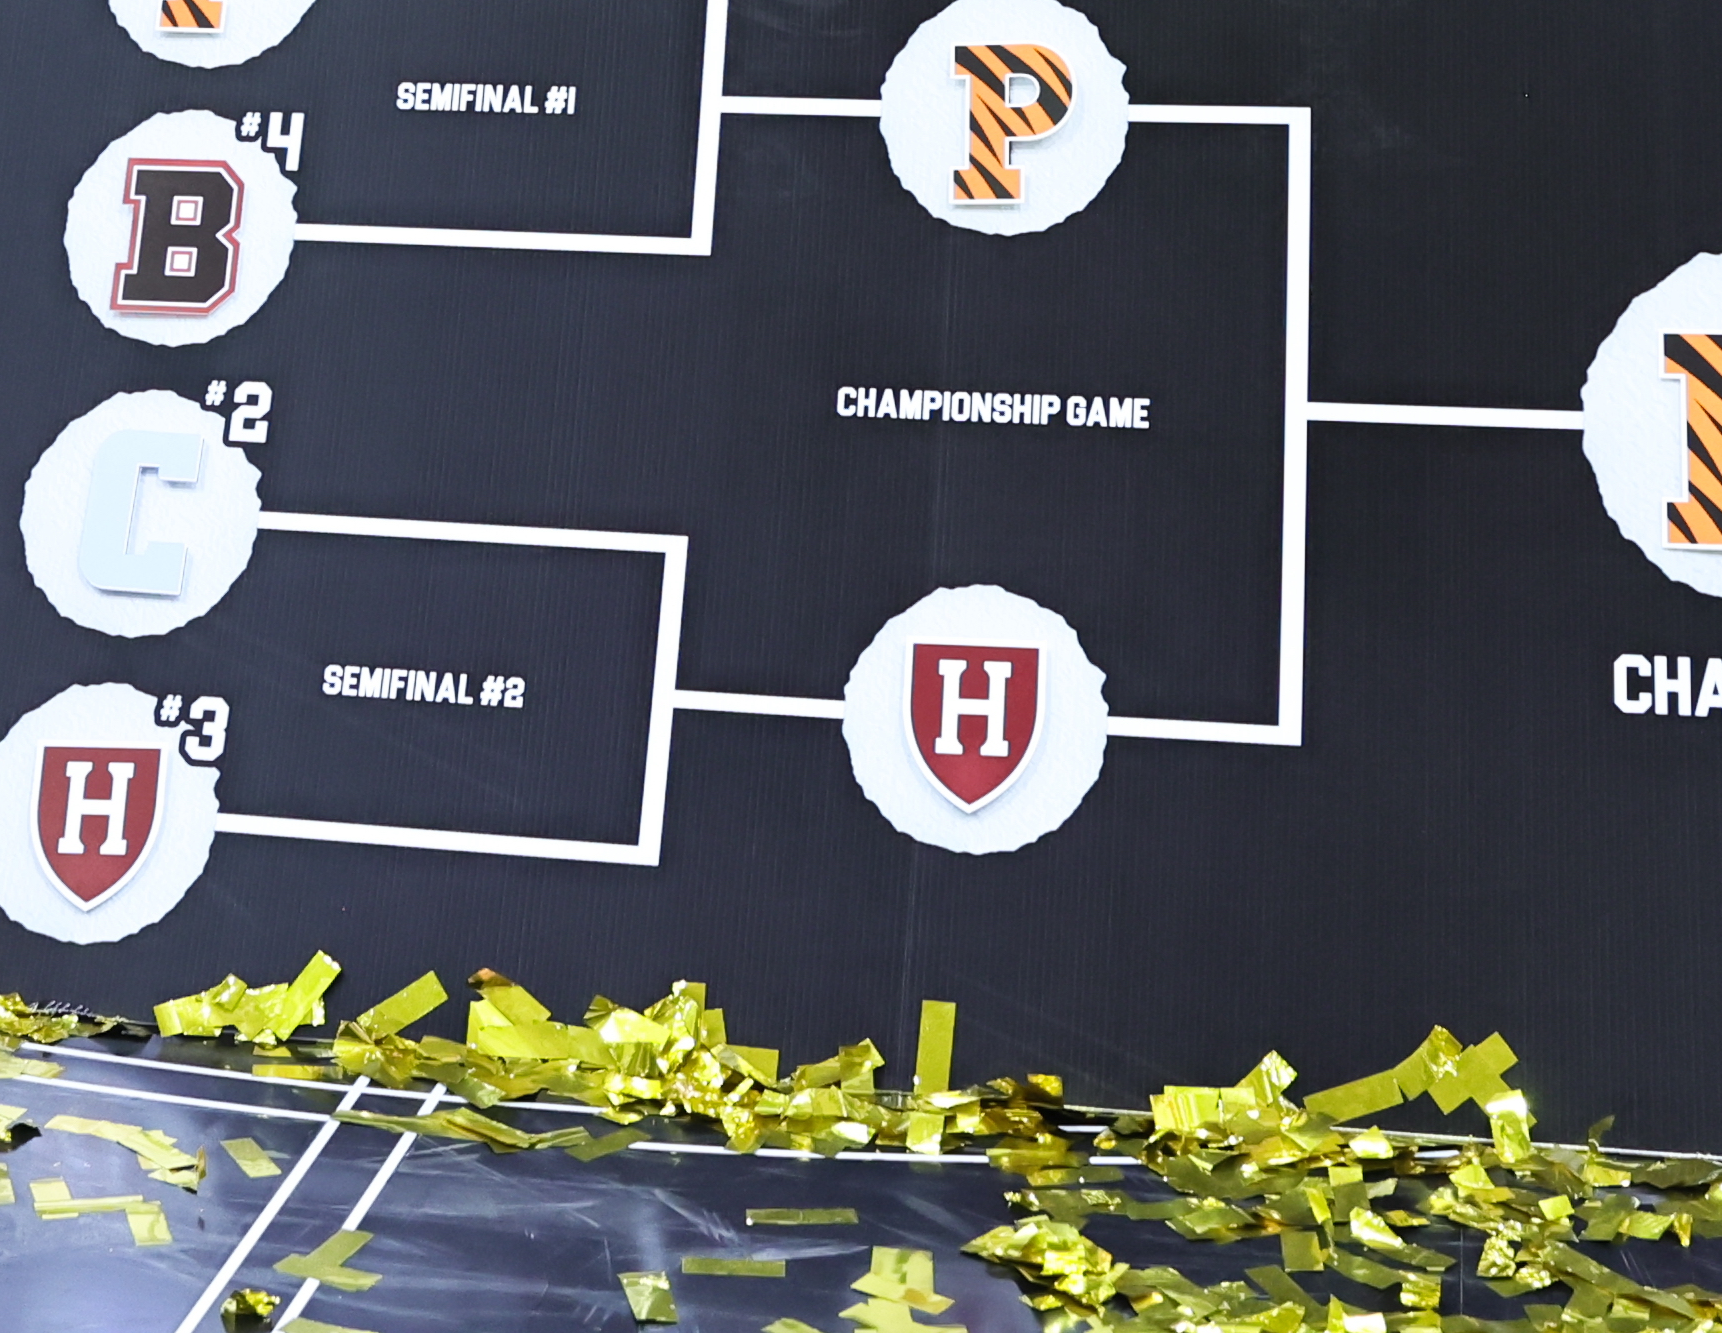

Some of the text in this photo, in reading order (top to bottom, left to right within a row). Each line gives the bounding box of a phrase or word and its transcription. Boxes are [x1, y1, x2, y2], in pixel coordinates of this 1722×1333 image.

[396, 82, 577, 116] SEMIFINAL #1
[948, 41, 1078, 206] P
[109, 157, 245, 316] B
[836, 386, 1151, 429] CHAMPIONSHIP GAME
[79, 428, 204, 596] C
[322, 664, 525, 710] SEMIFINAL #2
[934, 658, 1012, 757] H
[56, 761, 135, 856] H
